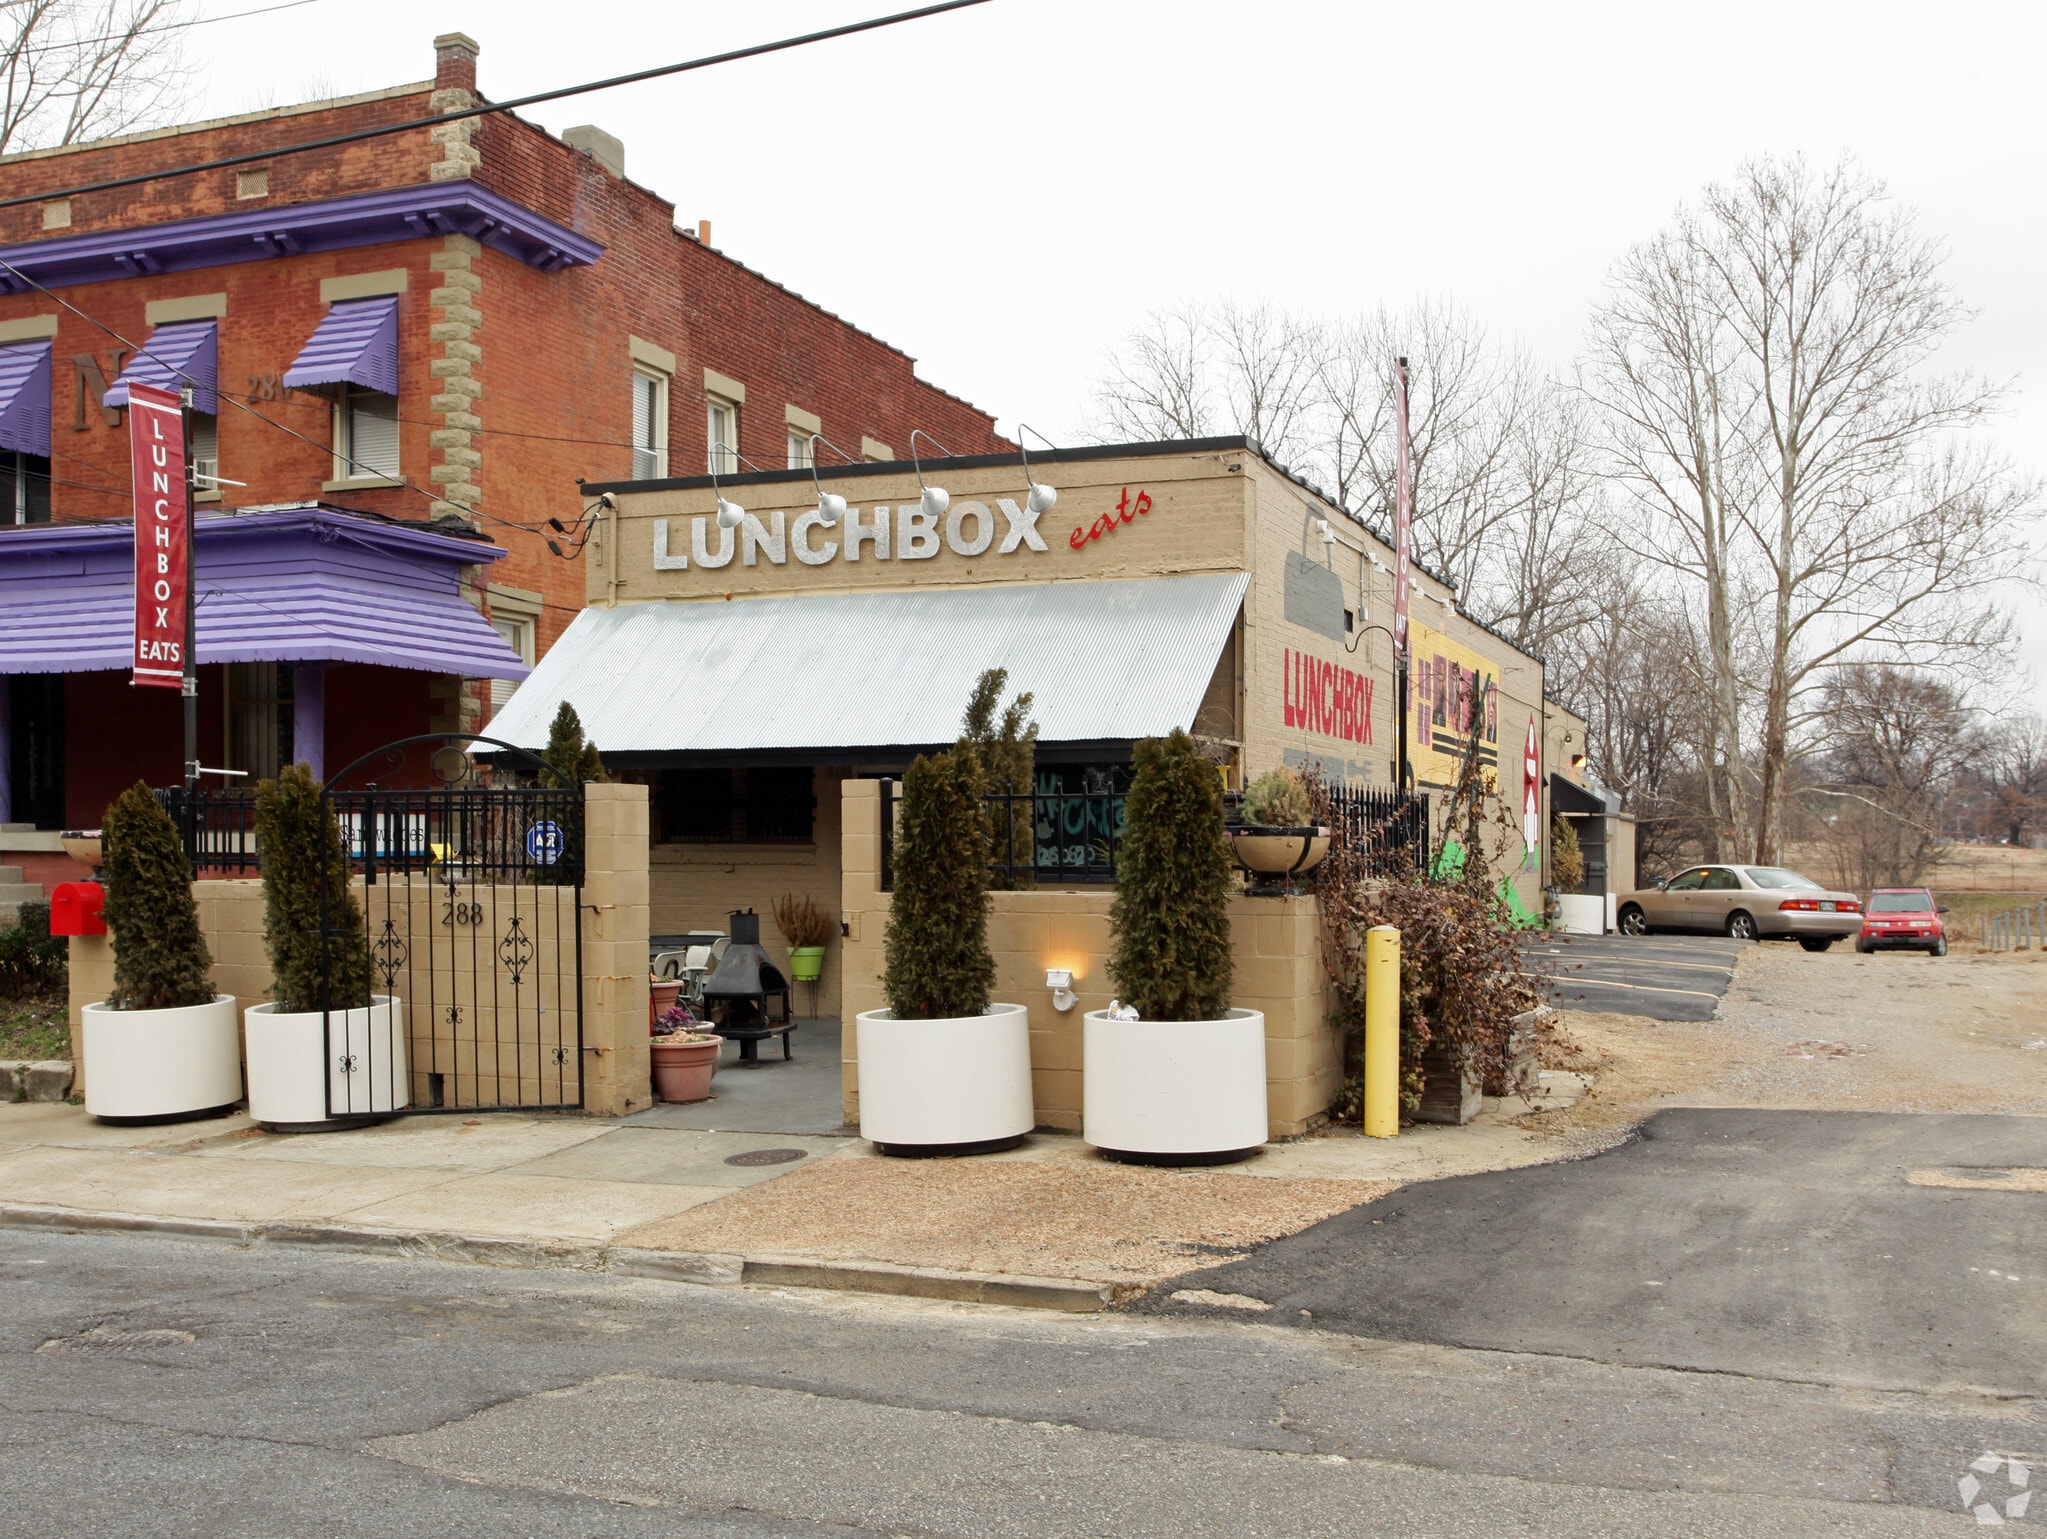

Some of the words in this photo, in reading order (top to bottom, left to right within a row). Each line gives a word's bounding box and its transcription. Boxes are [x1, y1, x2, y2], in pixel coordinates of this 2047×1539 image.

[152, 418, 170, 628] LUNCHBOX
[653, 498, 1049, 571] LUNCHBOX
[1069, 486, 1152, 550] eats
[139, 639, 181, 664] EATS
[1284, 647, 1375, 746] LUNCHBOX
[441, 902, 483, 926] 288
